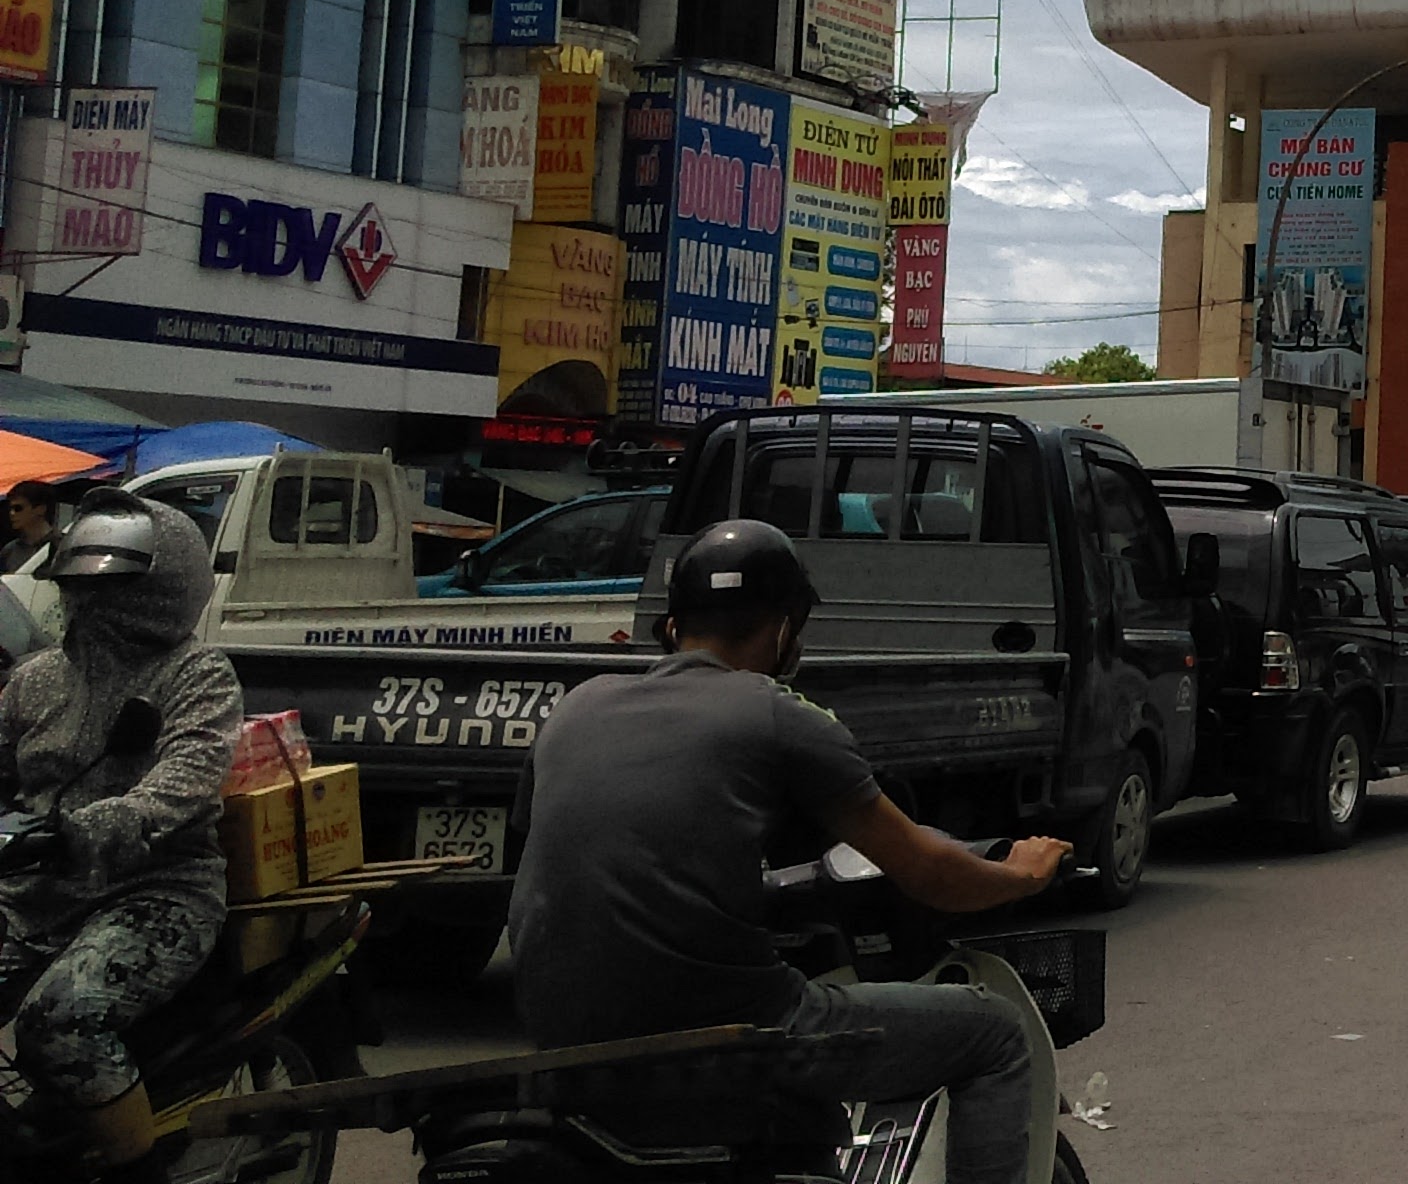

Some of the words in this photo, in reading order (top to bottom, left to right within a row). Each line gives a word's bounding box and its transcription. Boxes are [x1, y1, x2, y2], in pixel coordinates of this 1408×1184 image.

[113, 94, 150, 131] MÁY
[685, 76, 722, 125] Mai
[725, 87, 774, 148] Long
[804, 120, 848, 151] ĐIỆN
[855, 128, 879, 156] TỬ
[1317, 136, 1354, 154] BÁN
[678, 127, 745, 228] ĐỒNG
[748, 144, 783, 234] HỒ
[793, 148, 837, 191] MINH
[841, 159, 883, 200] DUNG
[893, 153, 913, 186] NỘI
[918, 149, 946, 180] THẤT
[1339, 160, 1365, 176] CƯ
[891, 192, 914, 219] ĐÀI
[1328, 186, 1363, 198] HOME
[624, 198, 664, 233] MÁY
[200, 192, 341, 281] BIDV
[903, 235, 940, 257] VÀNG
[676, 231, 723, 298] MÁY
[726, 239, 773, 305] TÍNH
[906, 271, 933, 292] BẠC
[668, 306, 723, 373] KÍNH
[726, 308, 771, 377] MẮT
[372, 627, 430, 644] MÁY
[436, 627, 503, 644] MINH
[373, 676, 444, 715] 37S
[475, 679, 567, 719] 6573
[331, 715, 537, 747] HYUND
[435, 810, 488, 838] 37S
[423, 842, 494, 870] 6573
